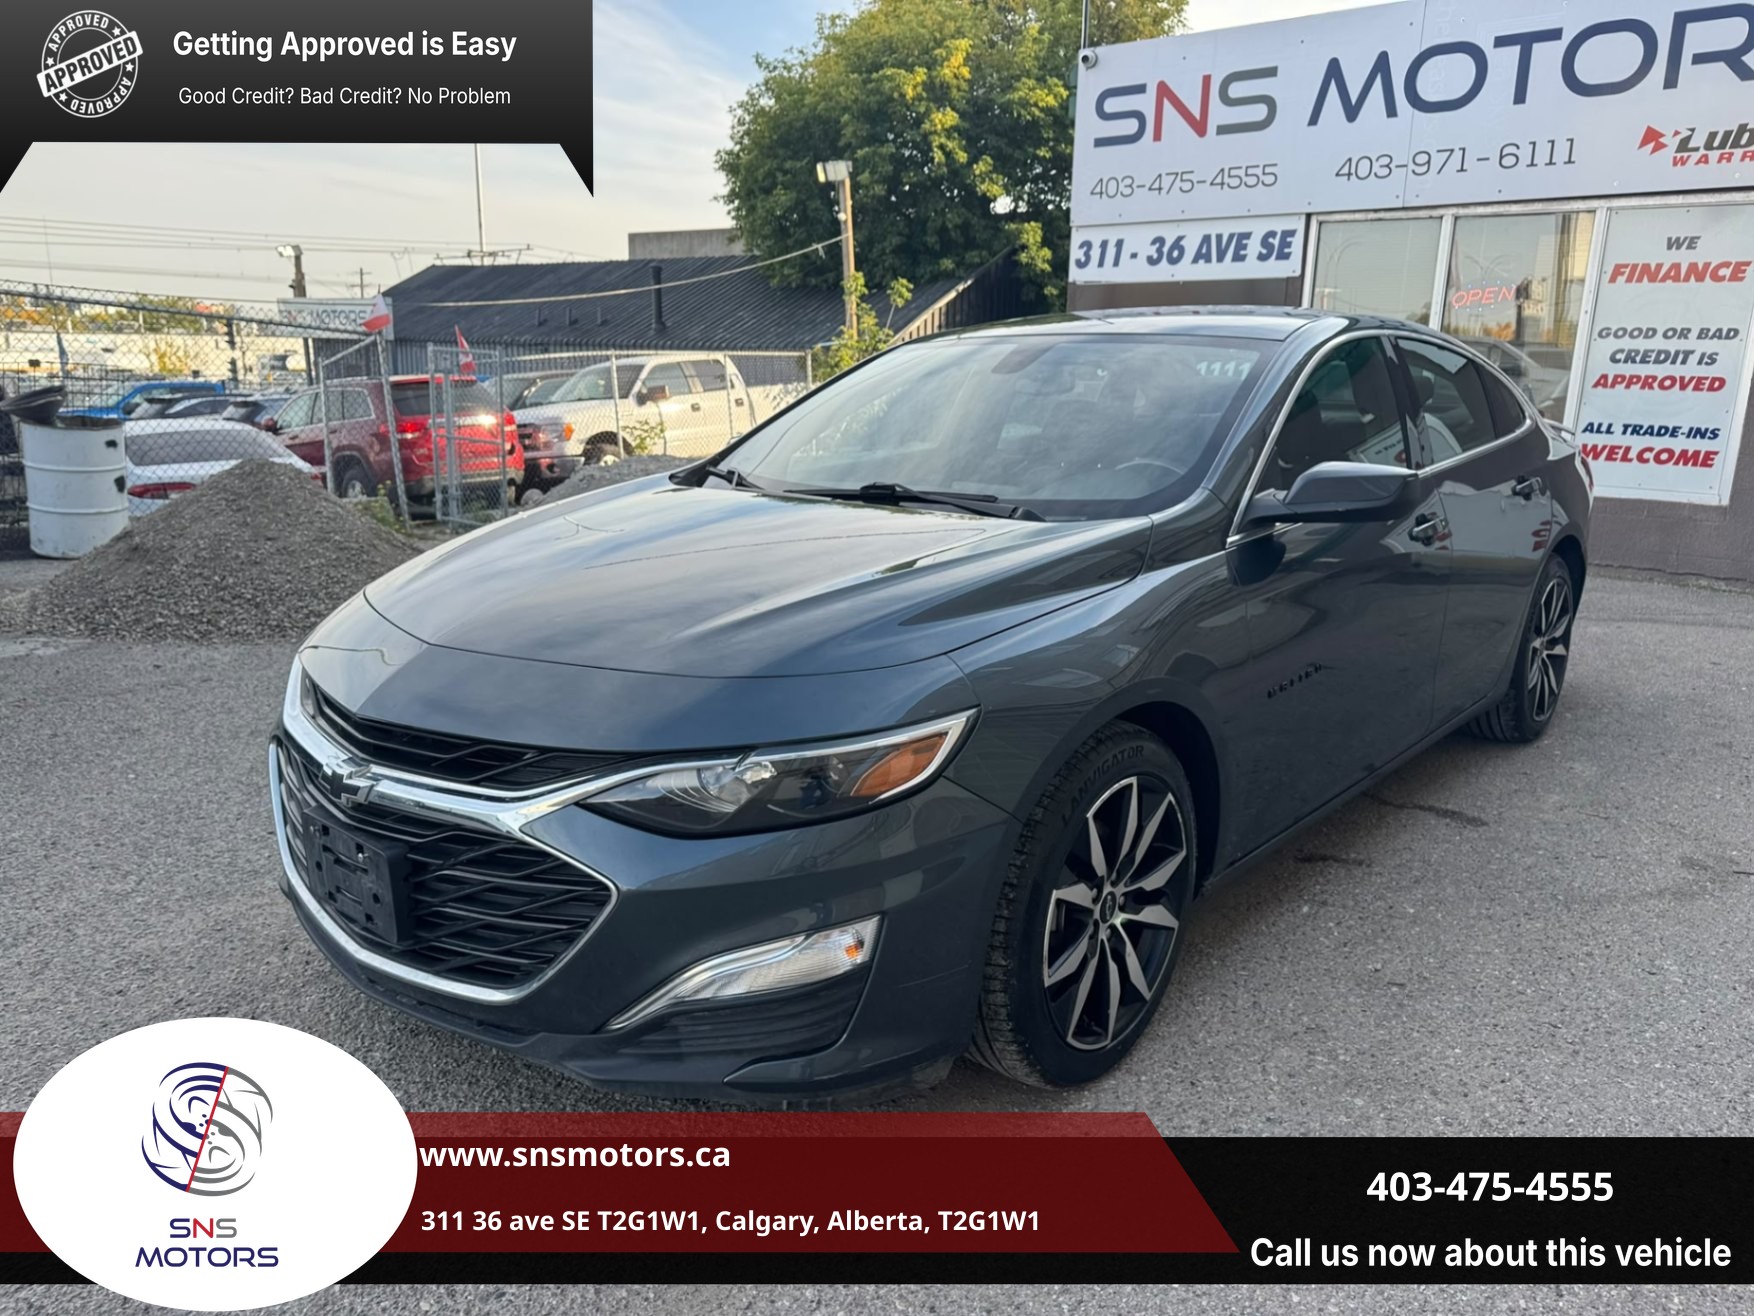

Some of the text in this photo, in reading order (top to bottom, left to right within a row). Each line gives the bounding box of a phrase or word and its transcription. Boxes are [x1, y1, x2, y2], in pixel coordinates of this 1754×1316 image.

[1093, 66, 1278, 148] SNS
[1090, 138, 1577, 199] 403-475-4555 403-971-6111
[1075, 238, 1124, 269] 311
[1146, 235, 1187, 266] 36
[1191, 231, 1254, 264] AVE
[1256, 228, 1298, 262] SE
[1665, 235, 1701, 251] WE
[1608, 260, 1752, 284] FINANCE
[1452, 286, 1516, 307] OPEN
[1597, 327, 1740, 341] GOOD OR BAD
[1609, 348, 1719, 366] CREDIT IS
[1592, 373, 1727, 393] APPROVED
[1581, 421, 1721, 440] ALL TRADE-INS
[1580, 443, 1720, 468] WELCOME
